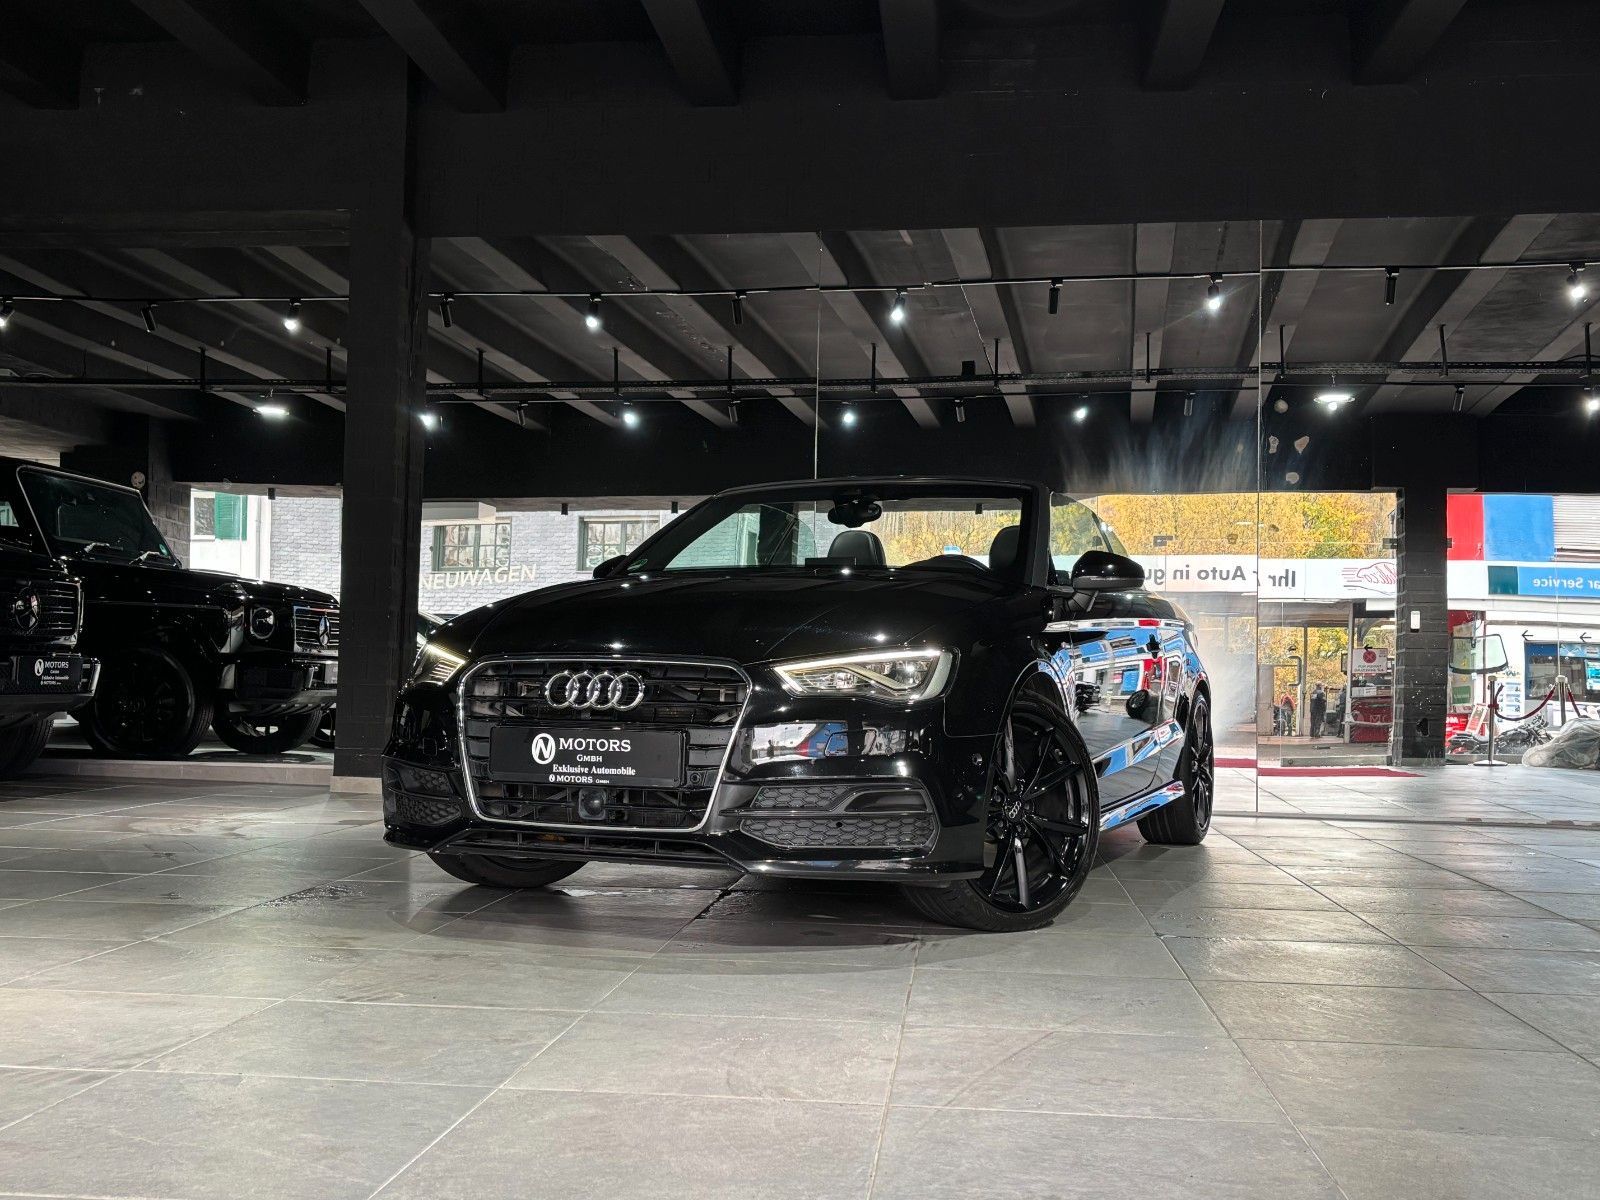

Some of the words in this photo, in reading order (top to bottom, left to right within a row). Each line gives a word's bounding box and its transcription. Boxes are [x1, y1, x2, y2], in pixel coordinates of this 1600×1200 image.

[419, 564, 536, 590] NEUWAGEN
[559, 738, 631, 752] MOTORS
[576, 754, 602, 762] GMBH
[553, 764, 589, 773] Exklusive
[591, 766, 636, 775] Automobile
[556, 775, 593, 784] MOTORS
